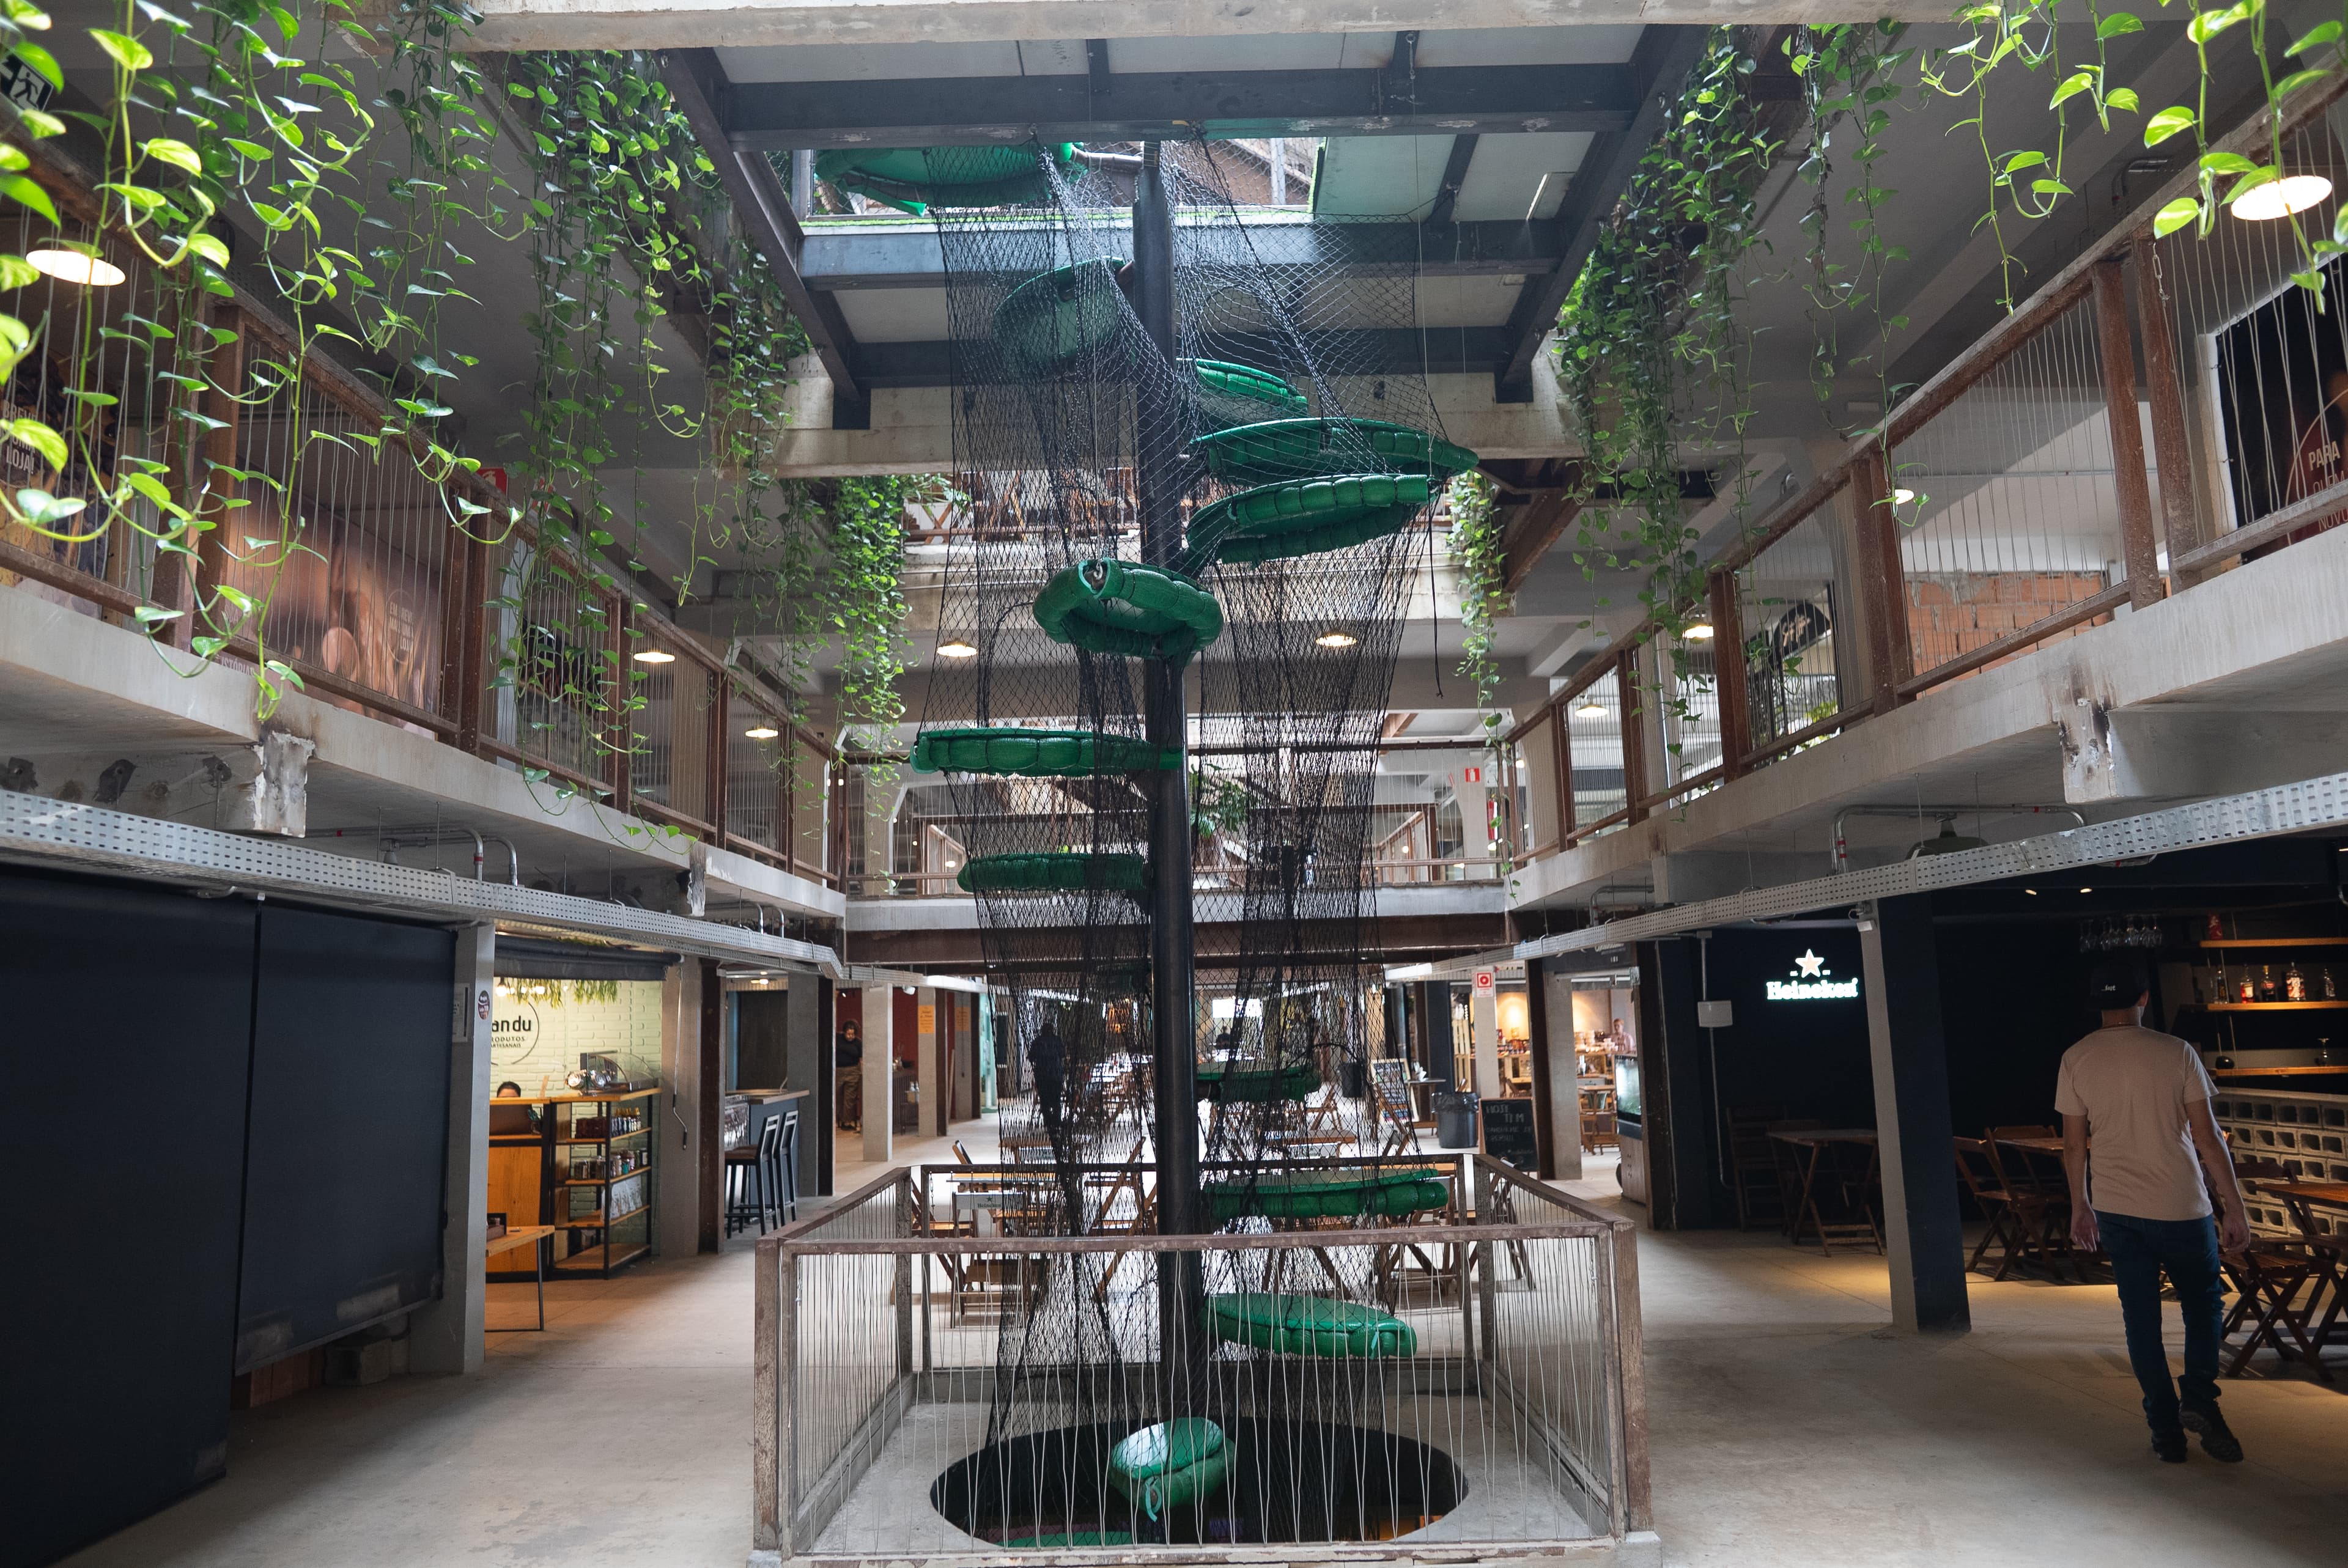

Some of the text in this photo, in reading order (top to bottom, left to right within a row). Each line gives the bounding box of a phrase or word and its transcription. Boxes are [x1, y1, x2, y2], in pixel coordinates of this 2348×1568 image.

[6, 445, 35, 474] LOJA!
[2309, 440, 2341, 471] PARA
[1766, 979, 1858, 1000] Heineken
[492, 1015, 531, 1032] andu
